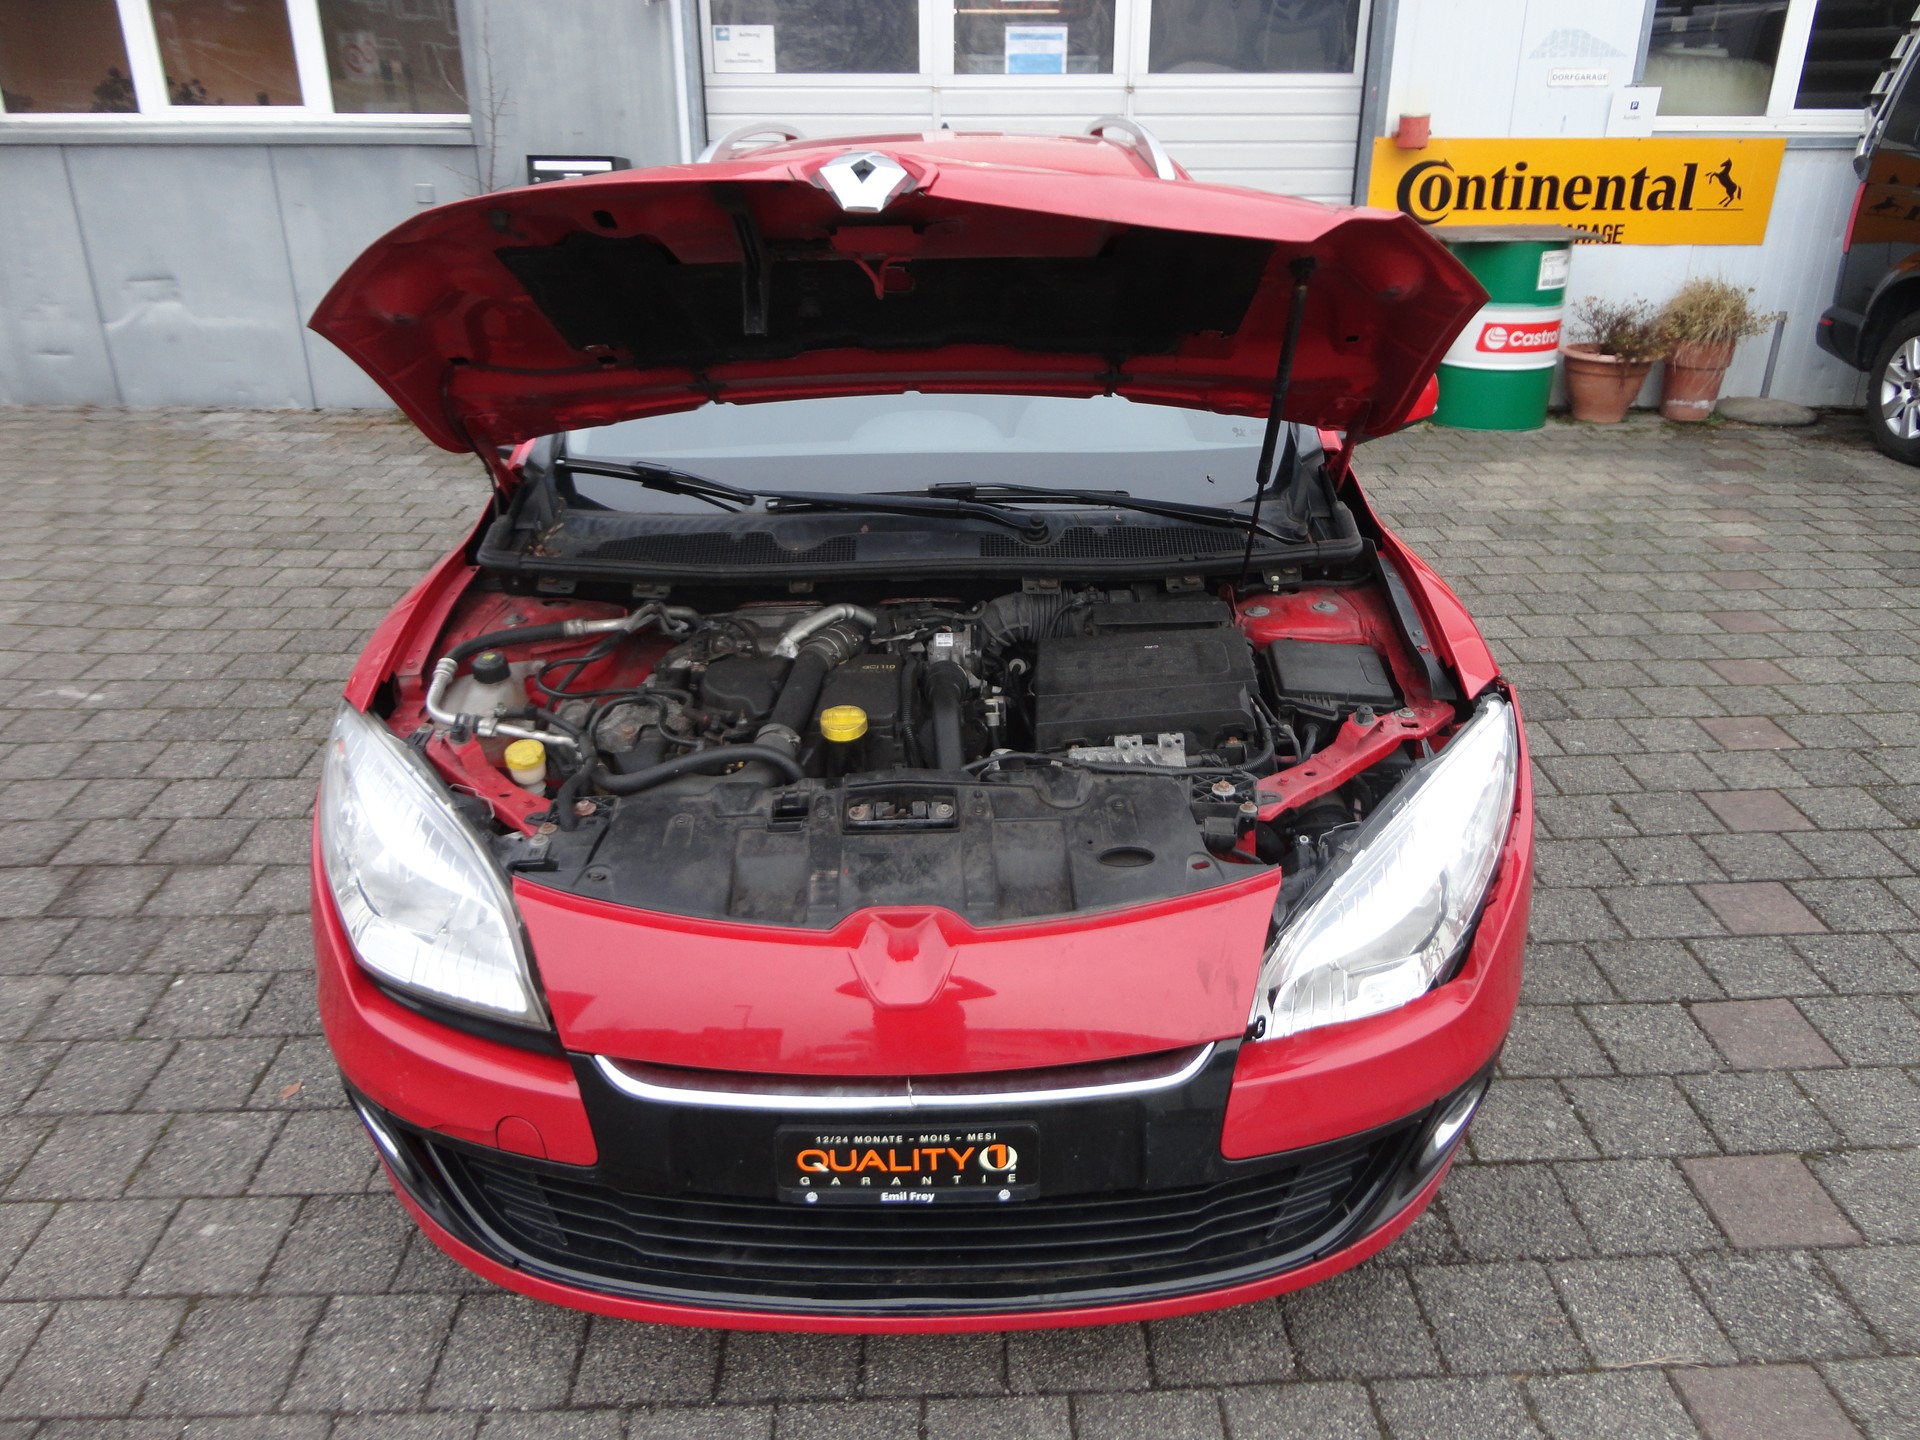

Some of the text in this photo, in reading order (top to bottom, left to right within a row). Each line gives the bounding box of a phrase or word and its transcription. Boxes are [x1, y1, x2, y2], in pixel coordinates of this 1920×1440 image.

[1552, 73, 1608, 81] DORFGARAGE
[1397, 158, 1698, 225] Continental
[815, 1135, 849, 1144] 12/24
[853, 1134, 903, 1143] MONATE
[919, 1133, 950, 1143] MOIS
[967, 1132, 997, 1142] MESI
[796, 1147, 975, 1172] QUALITY
[800, 1173, 1016, 1186] GARANTIE
[881, 1191, 935, 1203] Emil Frey
